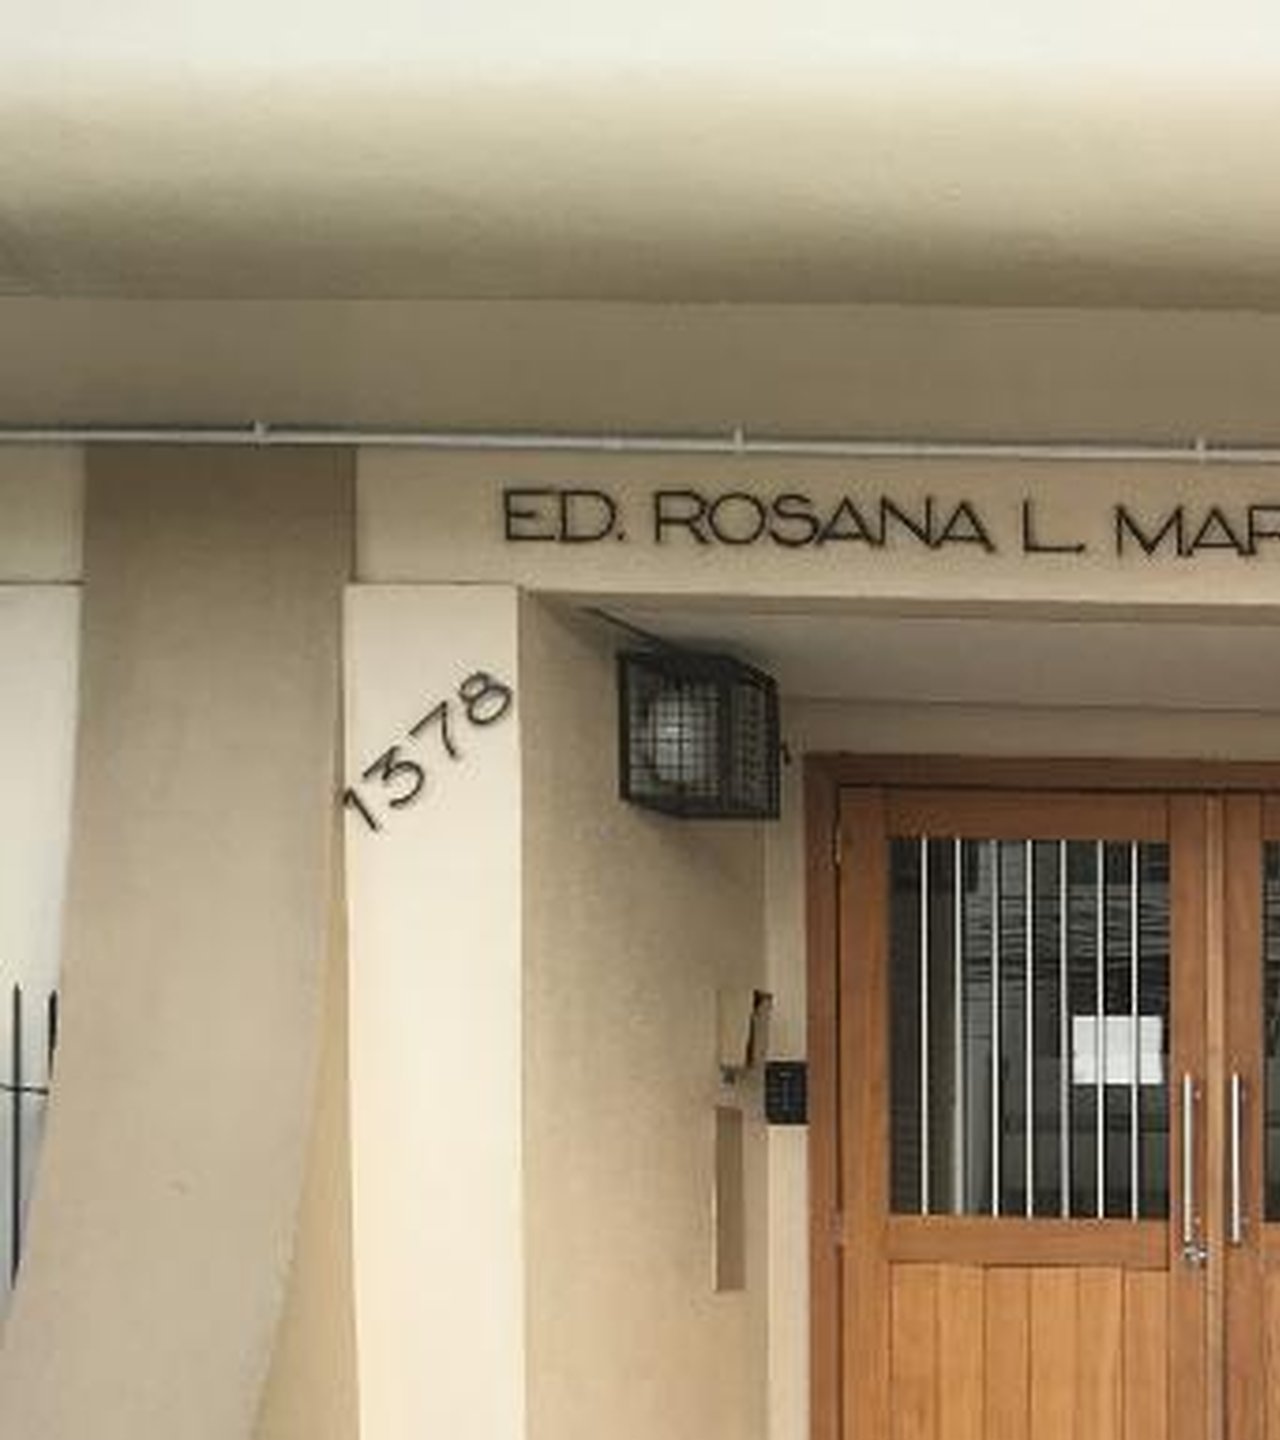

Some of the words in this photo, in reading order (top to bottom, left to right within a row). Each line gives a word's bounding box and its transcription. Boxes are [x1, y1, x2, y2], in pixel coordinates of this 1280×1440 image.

[502, 489, 628, 544] ED.
[653, 491, 995, 553] ROSANA
[341, 669, 513, 832] 1378
